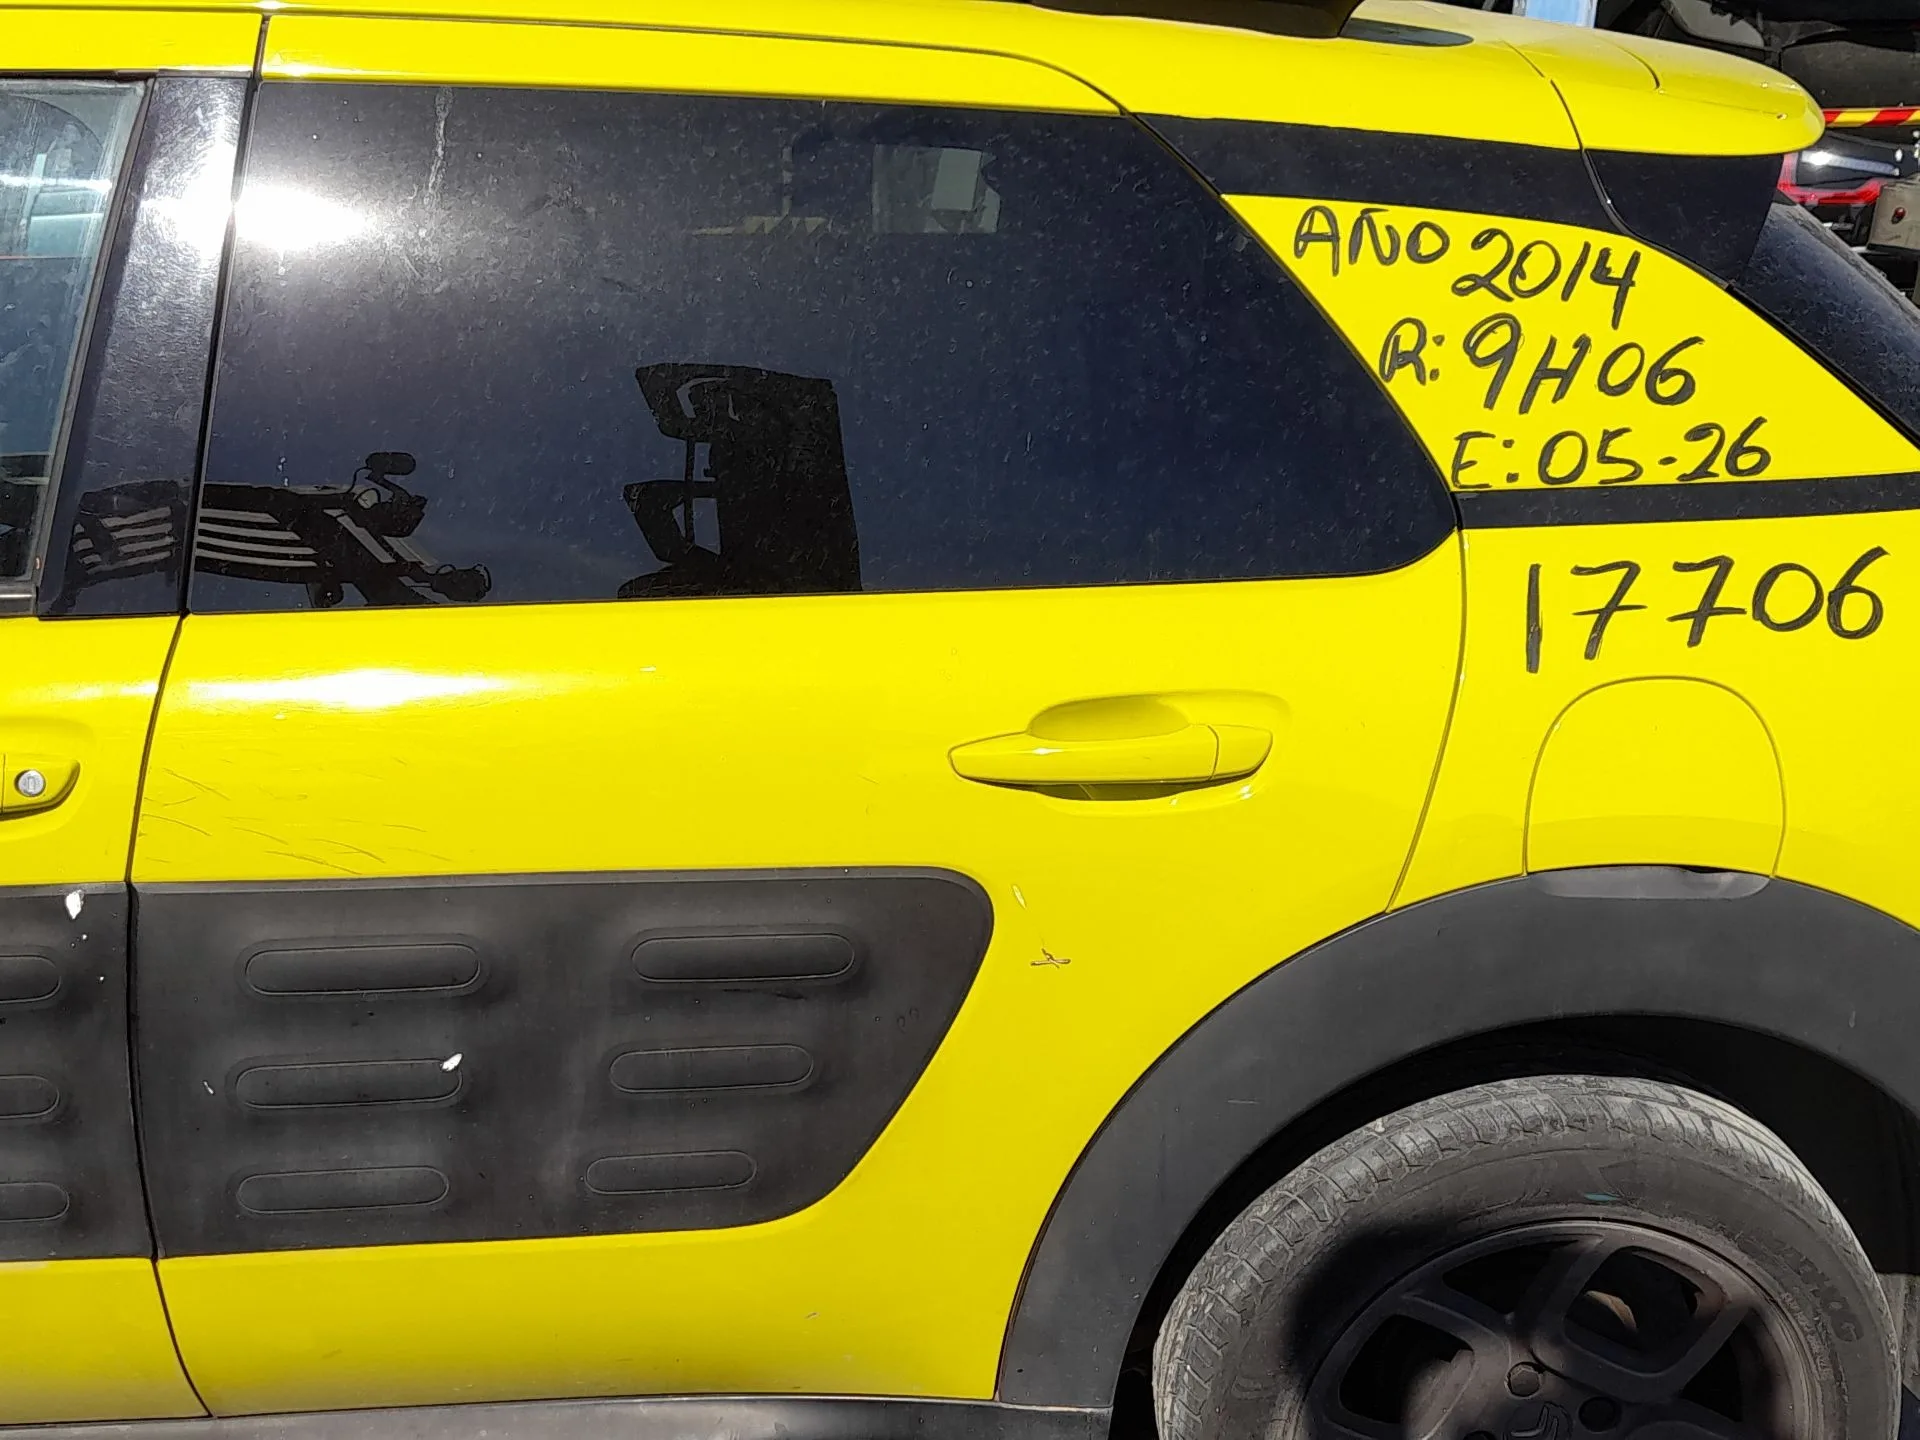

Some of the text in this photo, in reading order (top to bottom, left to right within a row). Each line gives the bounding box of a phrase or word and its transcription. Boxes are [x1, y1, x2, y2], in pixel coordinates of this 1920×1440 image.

[1451, 227, 1641, 331] 2014
[1378, 312, 1705, 415] R: 9H06
[1451, 416, 1772, 490] E: 05-26
[1525, 545, 1890, 674] 17706
